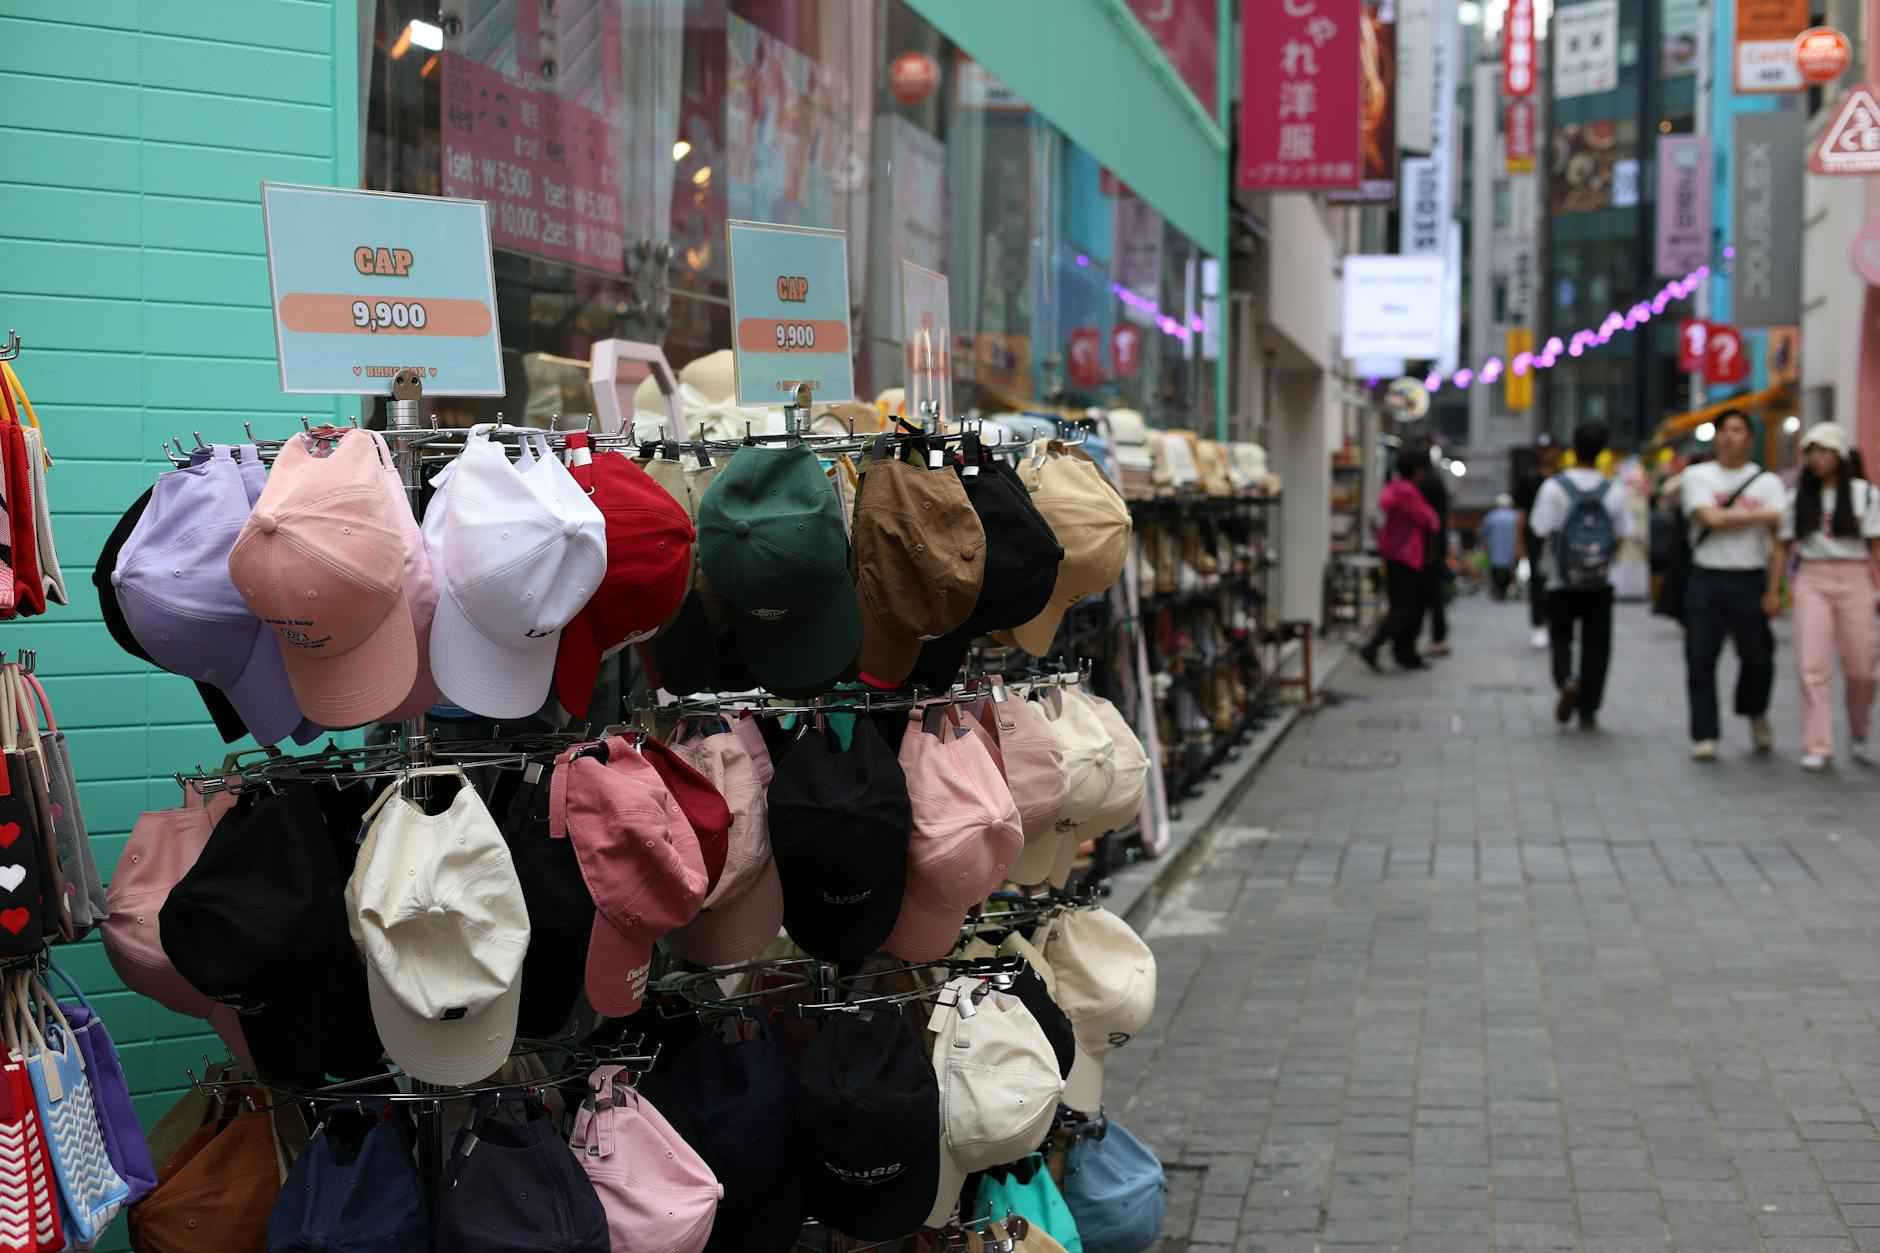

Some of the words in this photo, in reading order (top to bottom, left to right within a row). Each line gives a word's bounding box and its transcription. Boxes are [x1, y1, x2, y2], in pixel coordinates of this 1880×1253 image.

[354, 246, 414, 277] CAP
[777, 275, 808, 302] CAP
[352, 301, 427, 332] 9,900
[776, 324, 815, 352] 9,900
